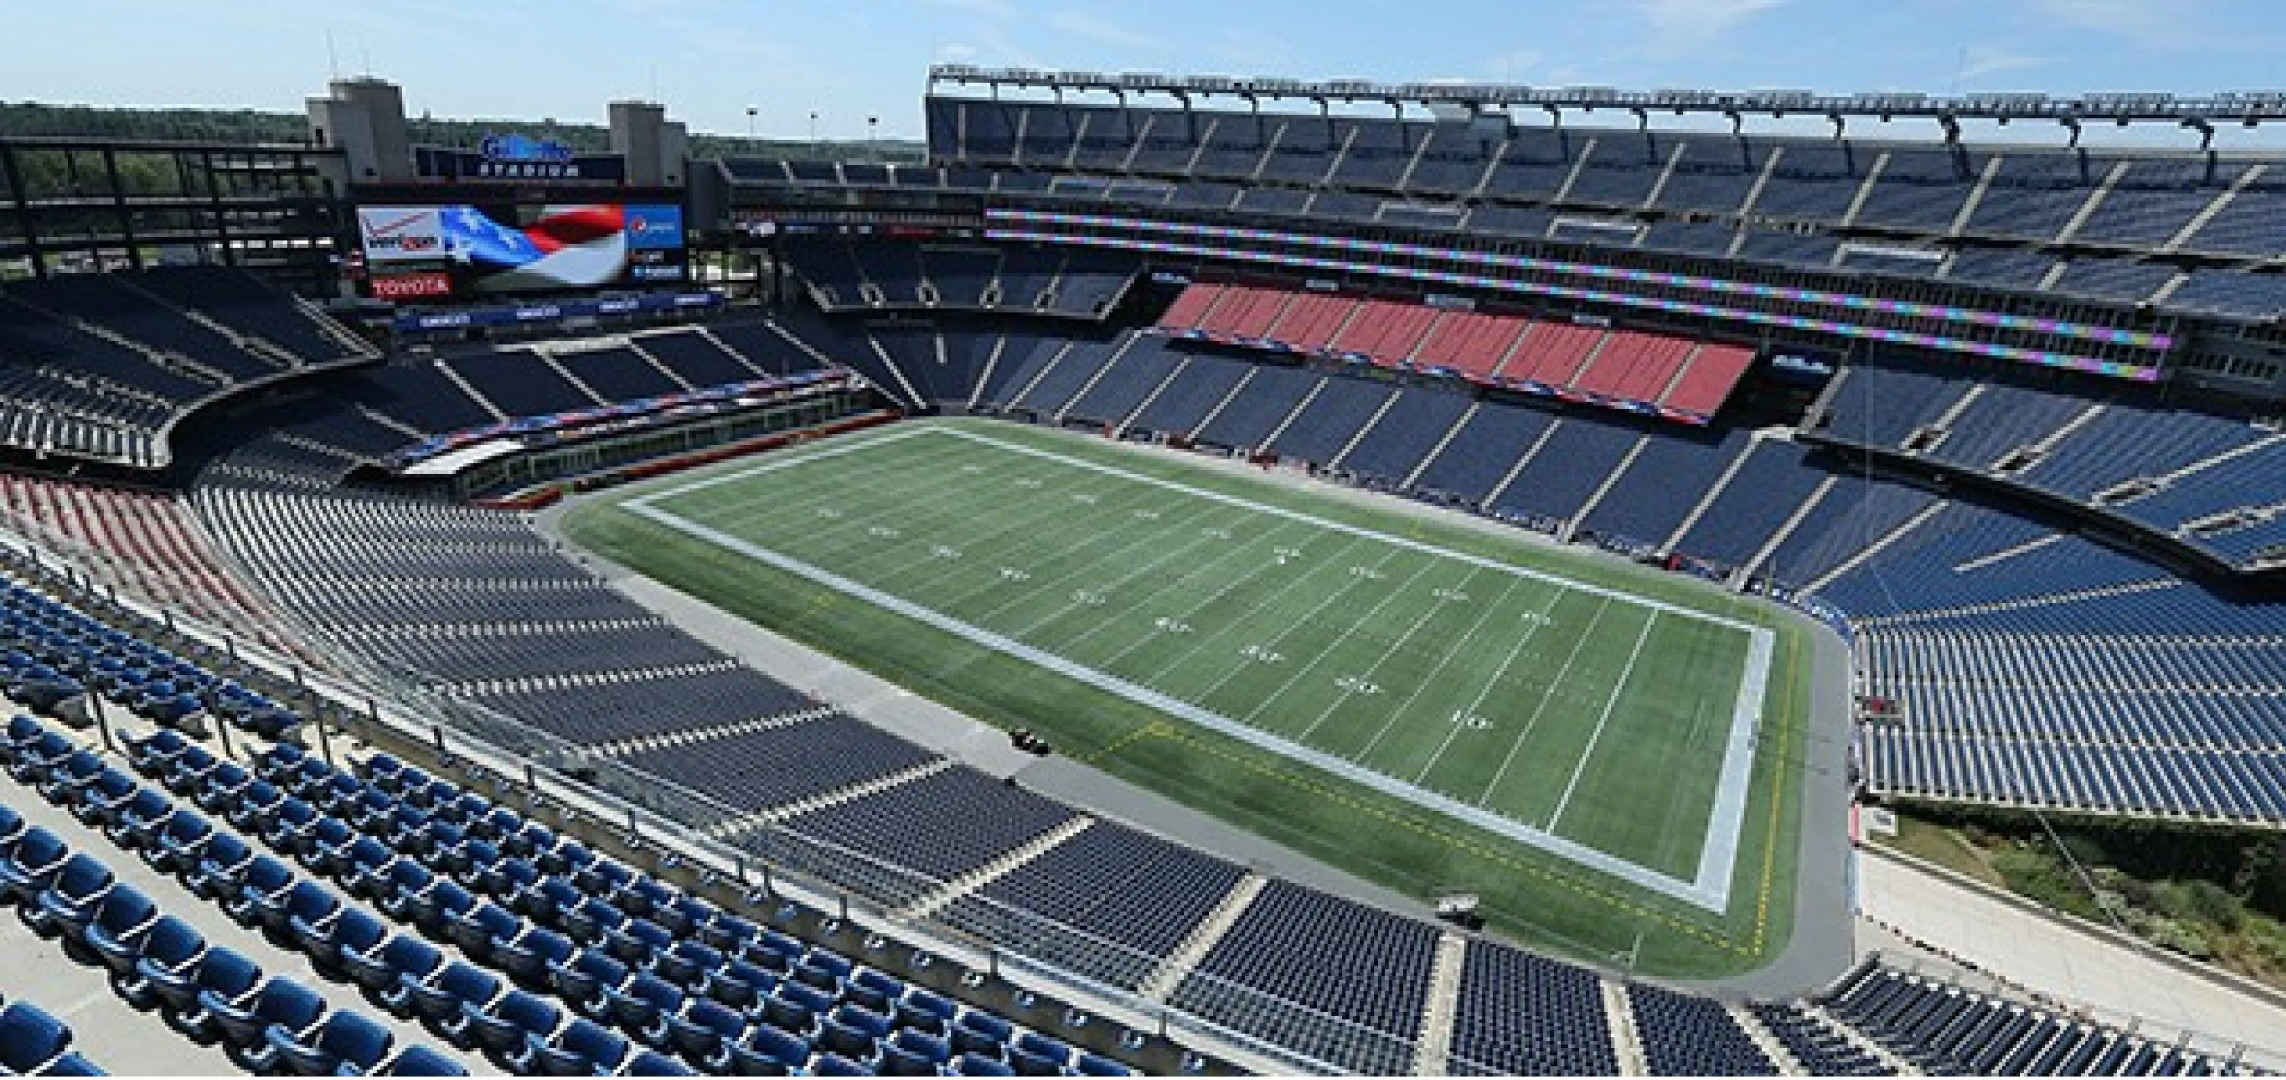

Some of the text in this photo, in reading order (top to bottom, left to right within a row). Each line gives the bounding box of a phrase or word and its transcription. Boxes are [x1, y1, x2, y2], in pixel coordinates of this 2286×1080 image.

[480, 164, 579, 177] STADIUM
[365, 230, 438, 251] verizon
[372, 279, 449, 295] TOYOTA
